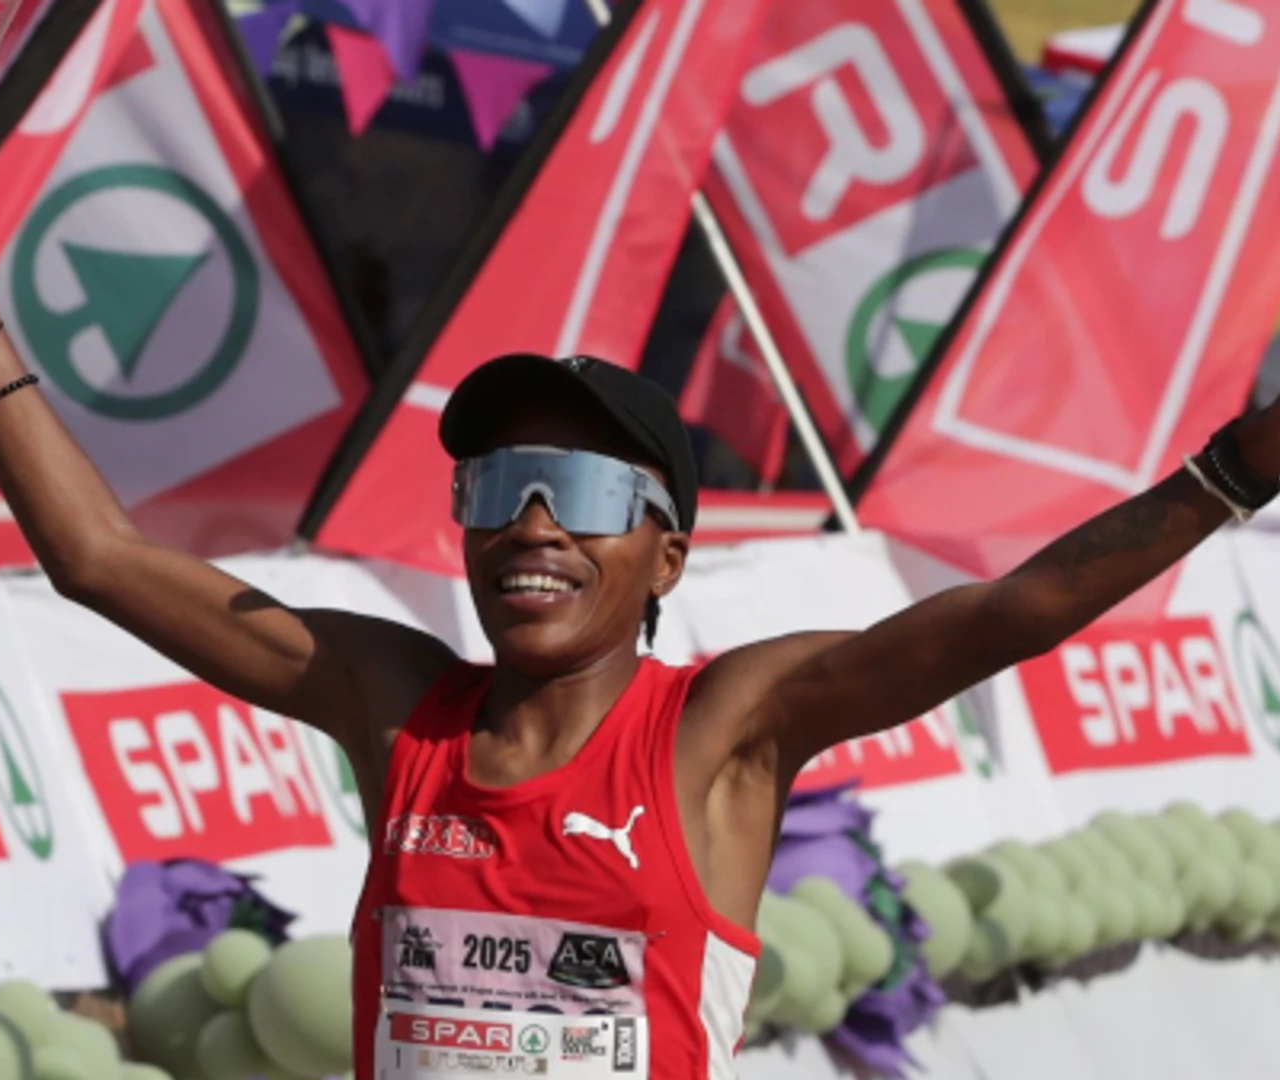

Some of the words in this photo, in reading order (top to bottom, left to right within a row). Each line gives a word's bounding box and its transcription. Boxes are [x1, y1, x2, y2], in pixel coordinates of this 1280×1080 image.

[1059, 635, 1244, 748] SPAR
[107, 702, 322, 840] SPAR
[462, 933, 532, 975] 2025
[558, 940, 619, 967] ASA
[411, 1019, 511, 1048] SPAR
